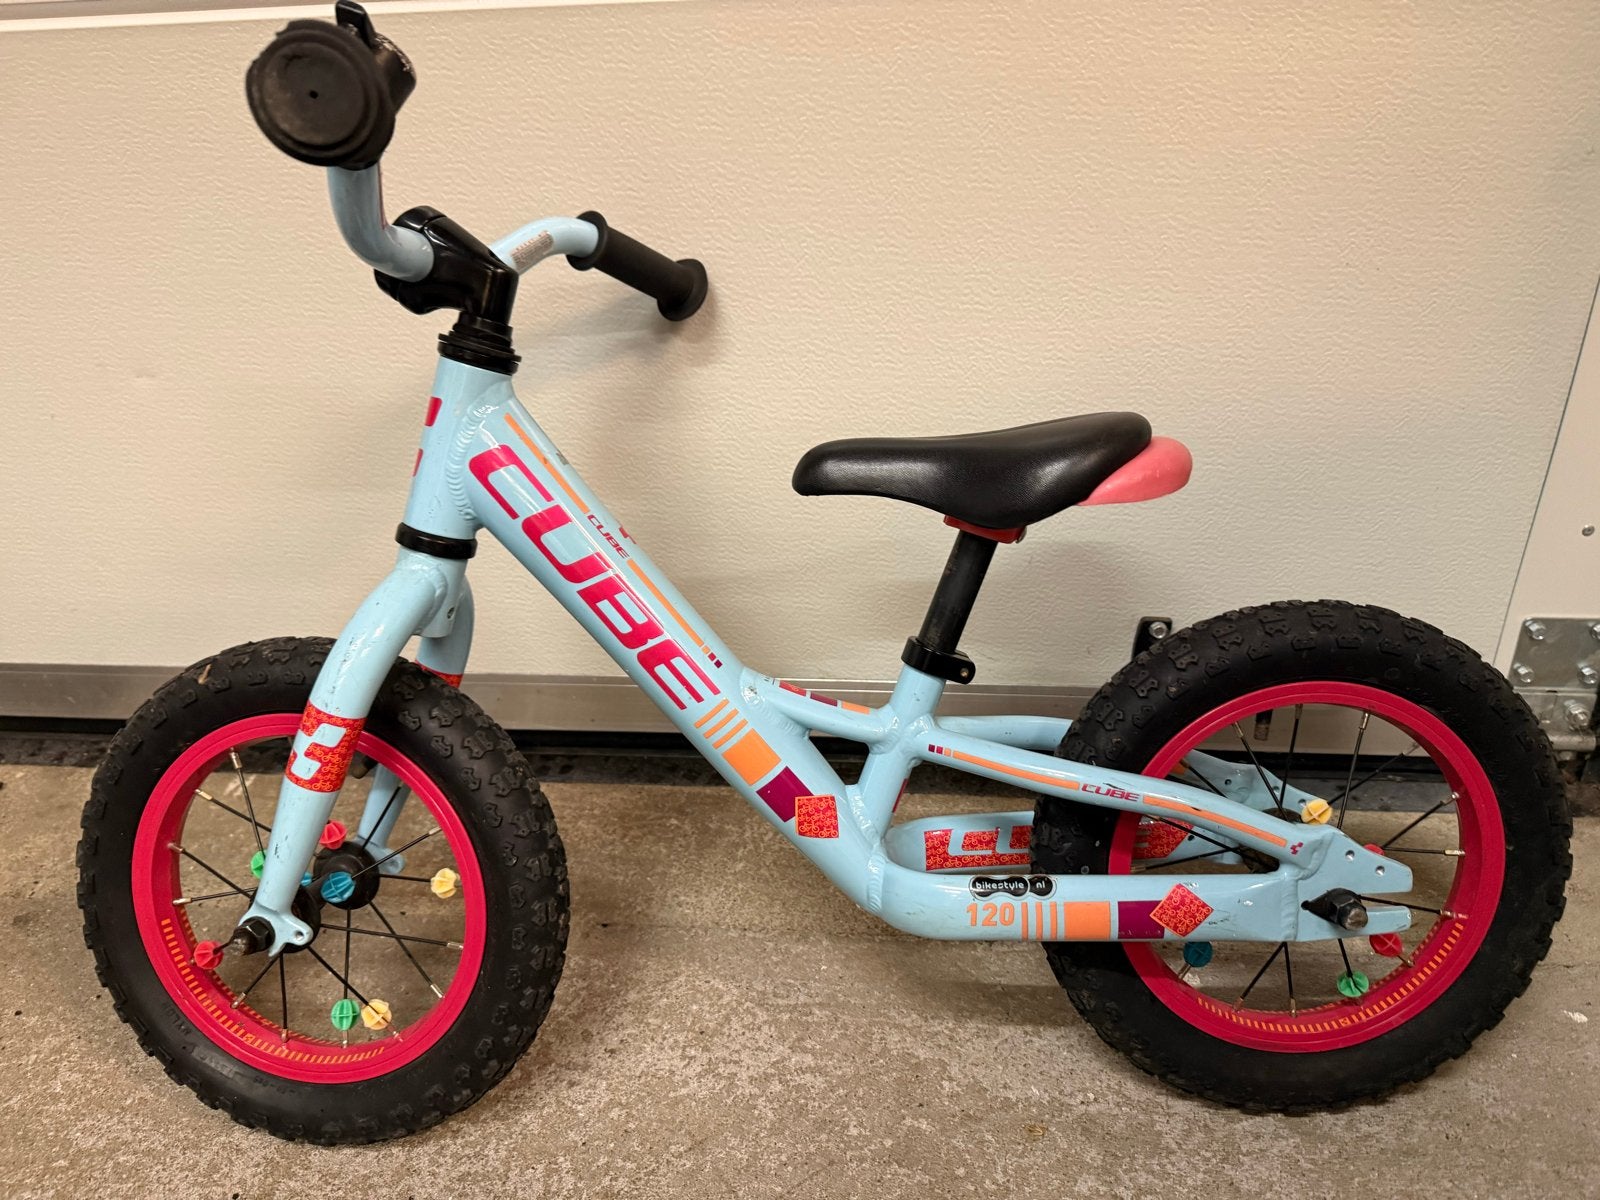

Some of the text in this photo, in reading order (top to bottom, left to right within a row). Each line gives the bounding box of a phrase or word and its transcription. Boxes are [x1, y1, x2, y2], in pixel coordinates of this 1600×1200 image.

[587, 514, 631, 559] CUBE
[469, 444, 721, 711] CUBE
[1081, 783, 1140, 802] CUBE
[975, 881, 1025, 891] bikestyle
[966, 902, 1015, 927] 120
